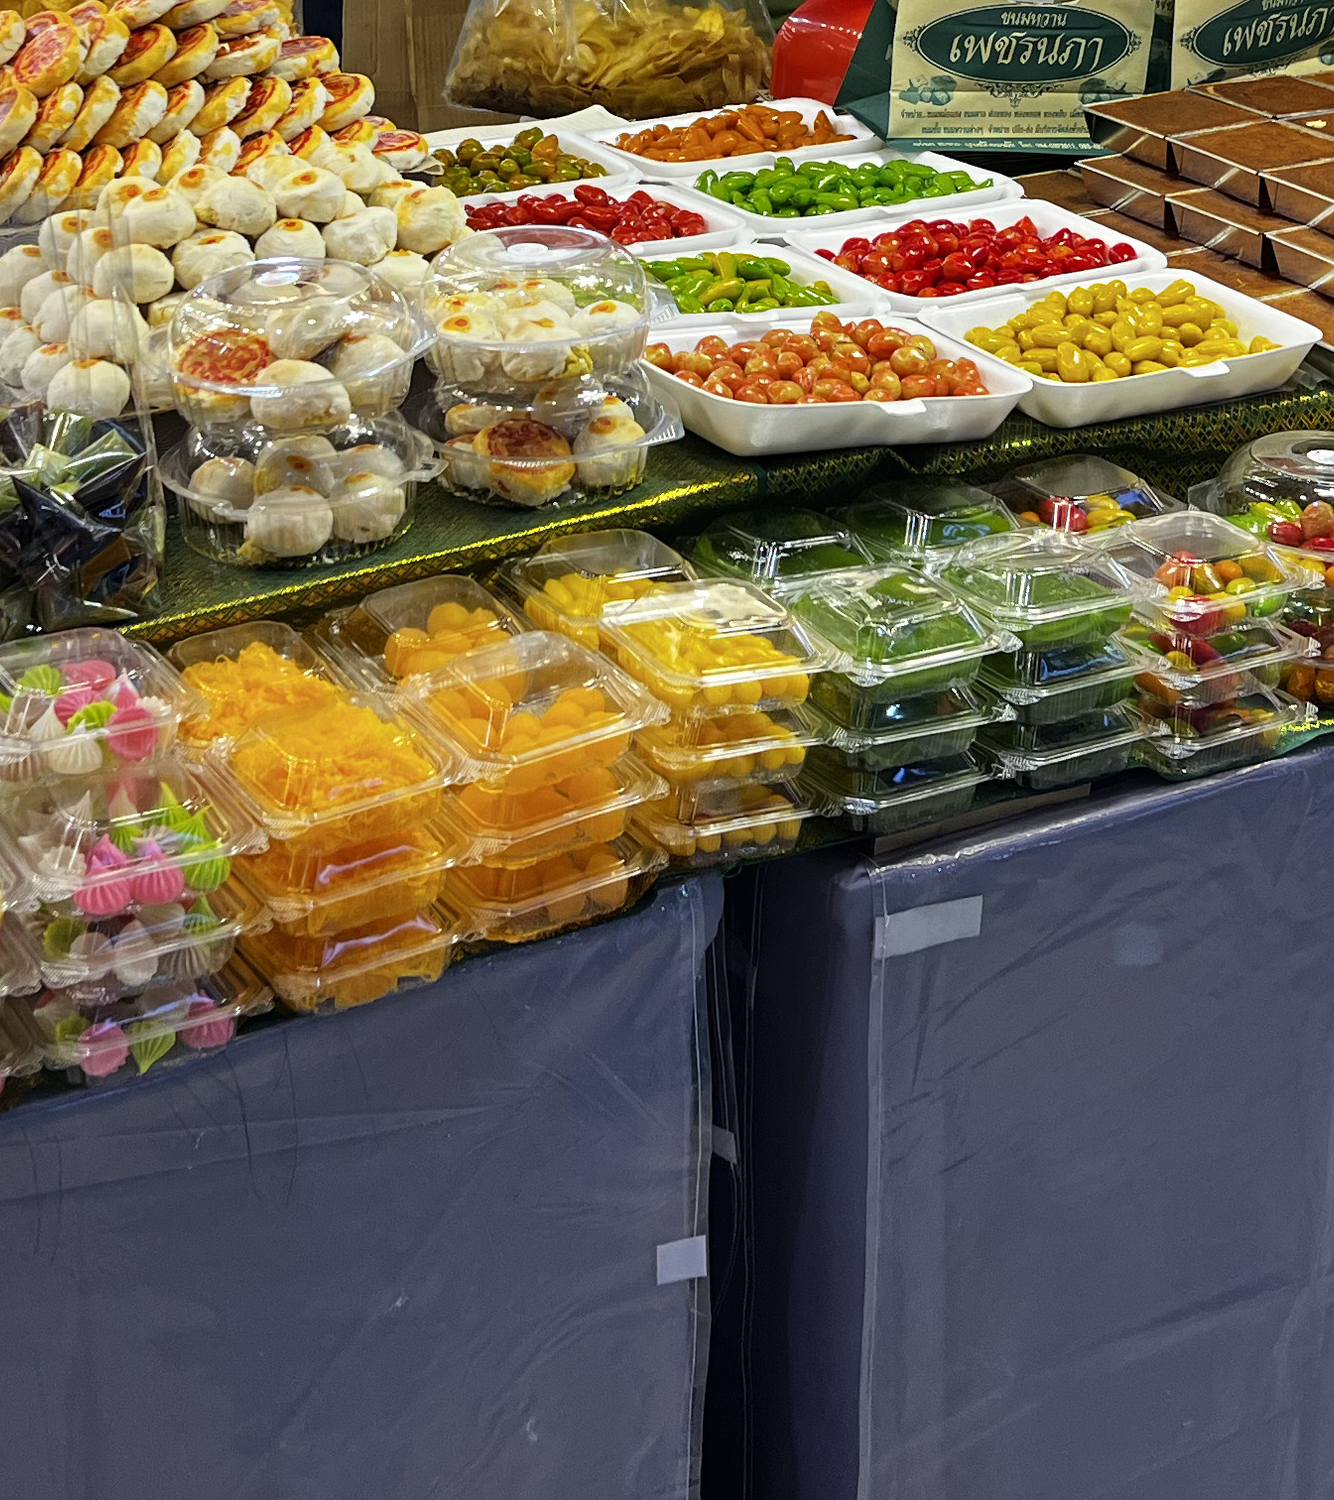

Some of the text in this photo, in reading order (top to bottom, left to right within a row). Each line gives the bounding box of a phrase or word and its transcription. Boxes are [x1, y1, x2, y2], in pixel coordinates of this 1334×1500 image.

[1001, 11, 1068, 29] ขนมหวาน
[949, 31, 1104, 73] เพชรนภา
